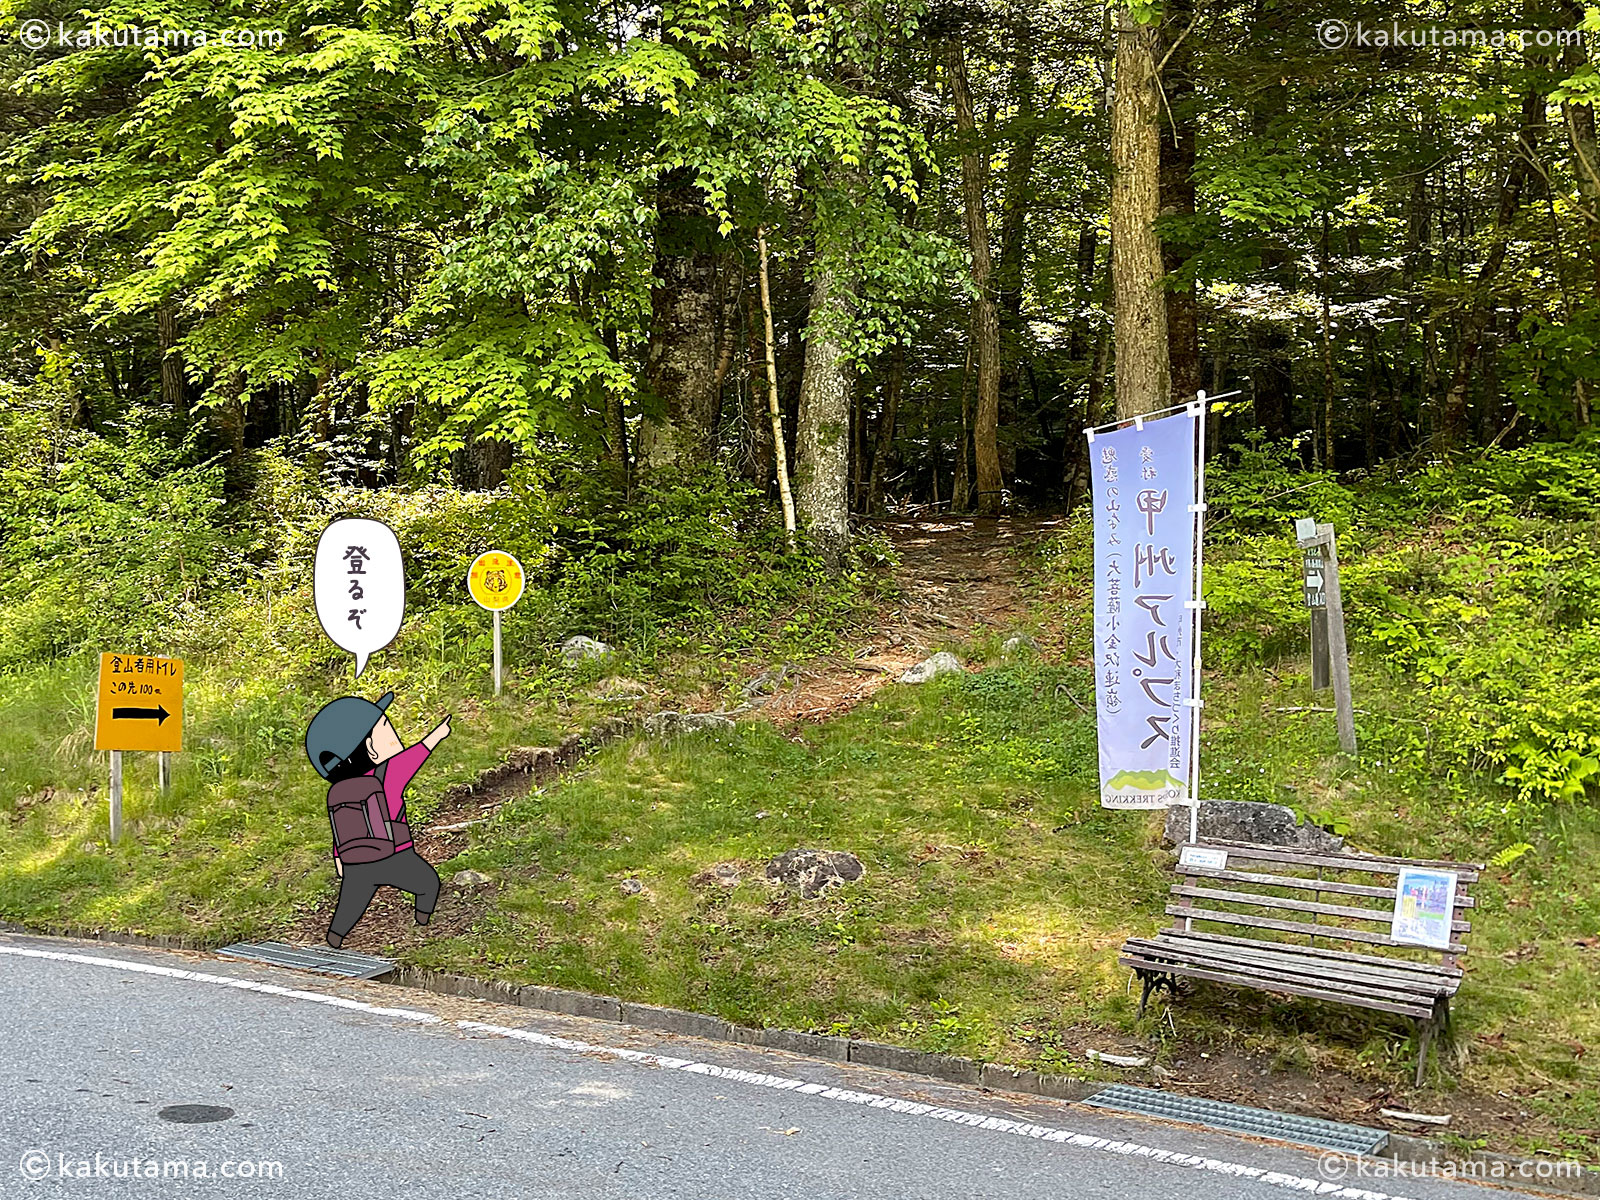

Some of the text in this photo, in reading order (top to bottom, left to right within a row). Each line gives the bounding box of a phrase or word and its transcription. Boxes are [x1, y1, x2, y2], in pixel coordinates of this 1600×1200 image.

[110, 656, 177, 676] 登山者用トイレ
